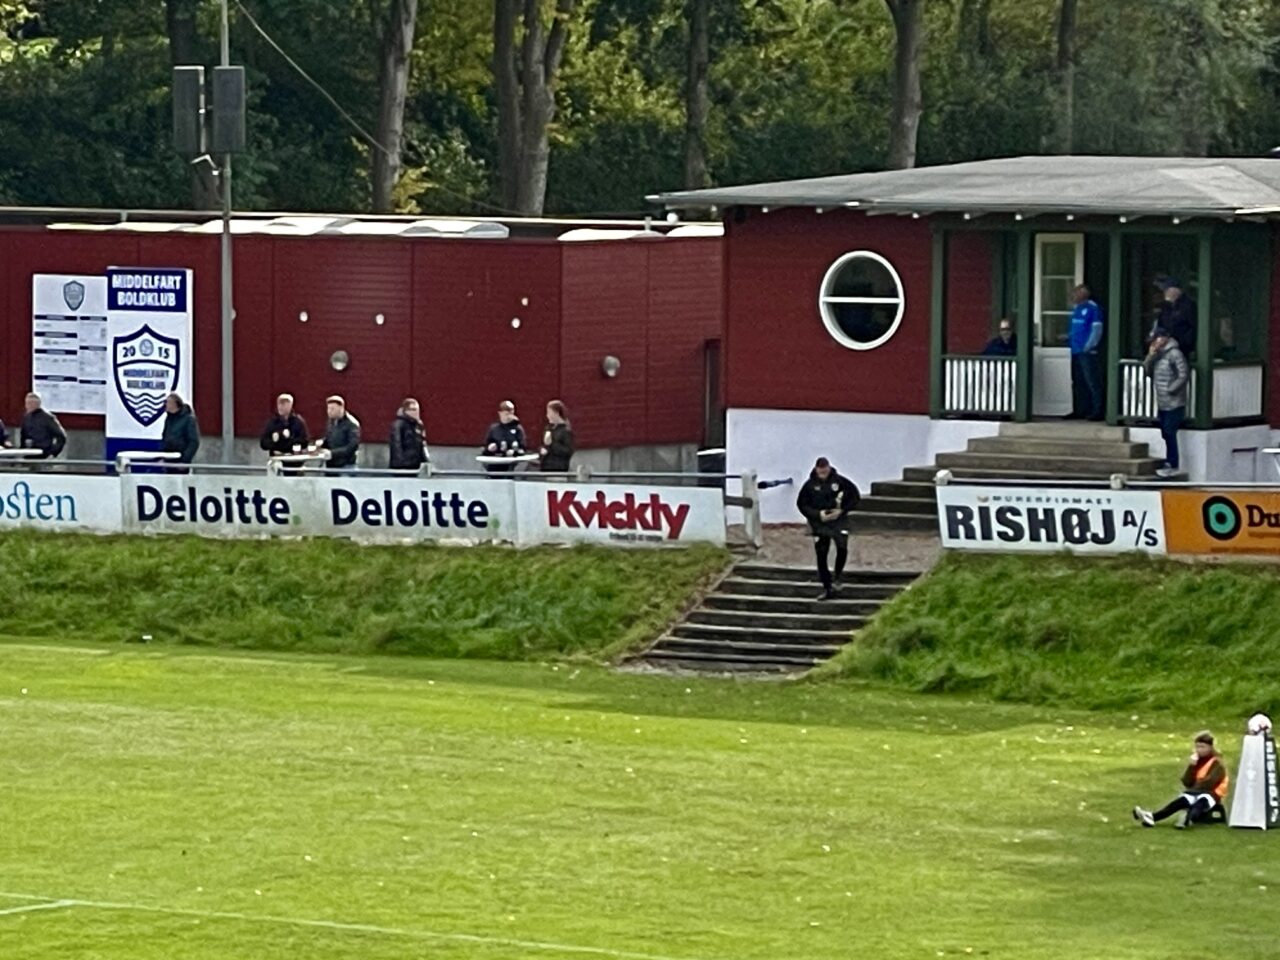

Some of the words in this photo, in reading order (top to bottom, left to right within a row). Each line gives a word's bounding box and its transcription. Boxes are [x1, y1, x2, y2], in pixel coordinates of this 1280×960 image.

[112, 274, 182, 290] MIDDELFART
[117, 292, 177, 307] BOLDKLUB
[122, 346, 136, 358] 20
[158, 346, 170, 359] 15
[547, 490, 690, 539] Kvickly
[945, 504, 1116, 545] RISHØJ
[1122, 509, 1159, 547] A/S
